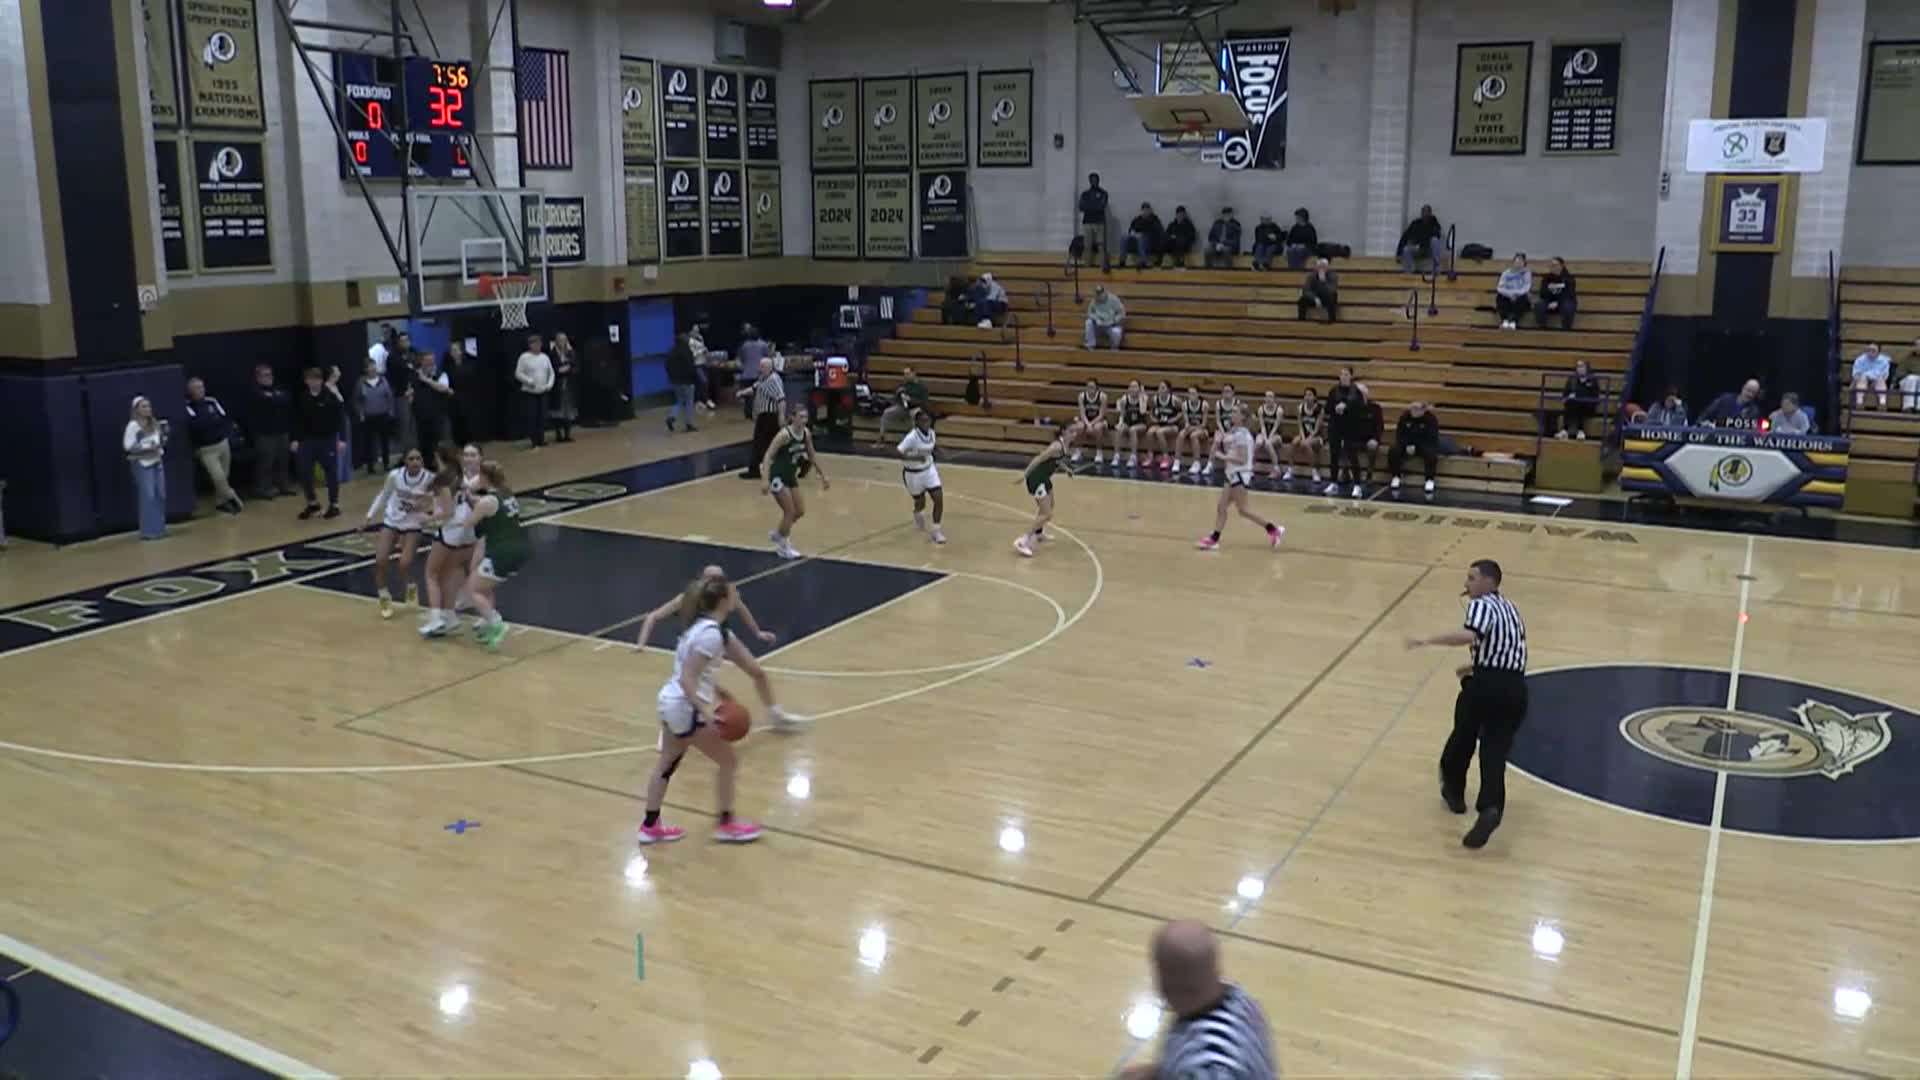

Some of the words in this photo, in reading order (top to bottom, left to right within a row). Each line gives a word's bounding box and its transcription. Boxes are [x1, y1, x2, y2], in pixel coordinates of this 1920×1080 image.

[1236, 44, 1280, 52] WARRIOR
[432, 64, 469, 88] 7:56
[346, 84, 391, 100] FOXBORO
[1236, 54, 1280, 125] FOCUS
[1564, 88, 1603, 97] LEAGUE
[198, 93, 253, 104] NATIONAL
[1552, 98, 1615, 107] CHAMPIONS
[194, 106, 259, 119] CHAMPIONS
[429, 86, 462, 127] 32
[368, 102, 381, 129] 0
[1459, 136, 1519, 145] CHAMPIONS
[356, 141, 367, 162] 0
[213, 193, 252, 204] LEAGUE
[203, 205, 264, 216] CHAMPIONS
[820, 208, 851, 223] 2024
[870, 208, 903, 223] 2024
[1738, 208, 1757, 223] 33
[1726, 417, 1758, 430] POSS
[1641, 429, 1682, 443] HOME
[1689, 431, 1708, 444] OF
[1717, 434, 1746, 446] THE
[1754, 436, 1833, 452] WARRIORS
